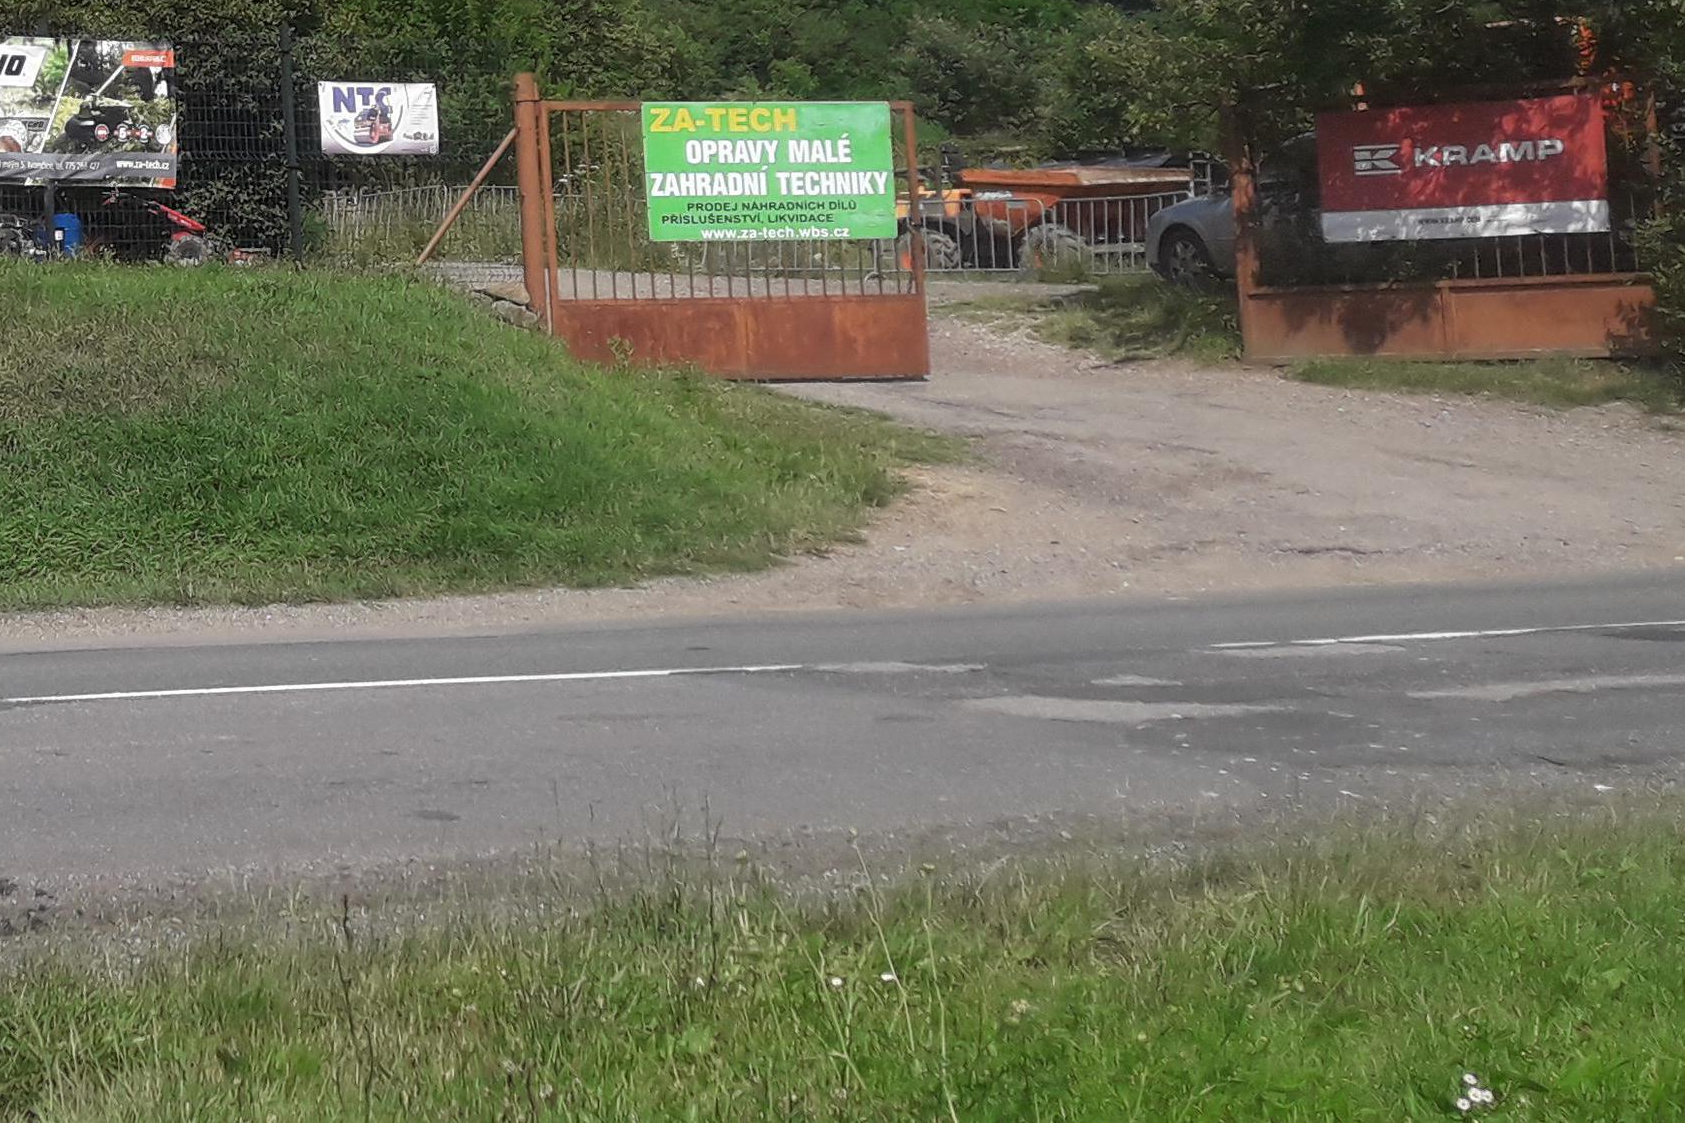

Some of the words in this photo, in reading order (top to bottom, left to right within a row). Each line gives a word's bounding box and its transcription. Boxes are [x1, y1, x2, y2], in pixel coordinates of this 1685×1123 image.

[650, 107, 797, 132] ZA-TECH
[685, 139, 778, 164] OPRAVY
[789, 134, 851, 163] MALÉ
[1415, 140, 1564, 167] KRAMP
[651, 166, 767, 196] ZAHRADNÍ
[776, 171, 887, 195] TECHNIKY
[687, 202, 738, 212] PRODEJ
[742, 200, 825, 212] NÁHRADNÍCH
[829, 199, 857, 211] DÍLŮ
[768, 213, 834, 224] LIKVIDACE
[701, 226, 851, 240] www.za-tech.wbs.cz
